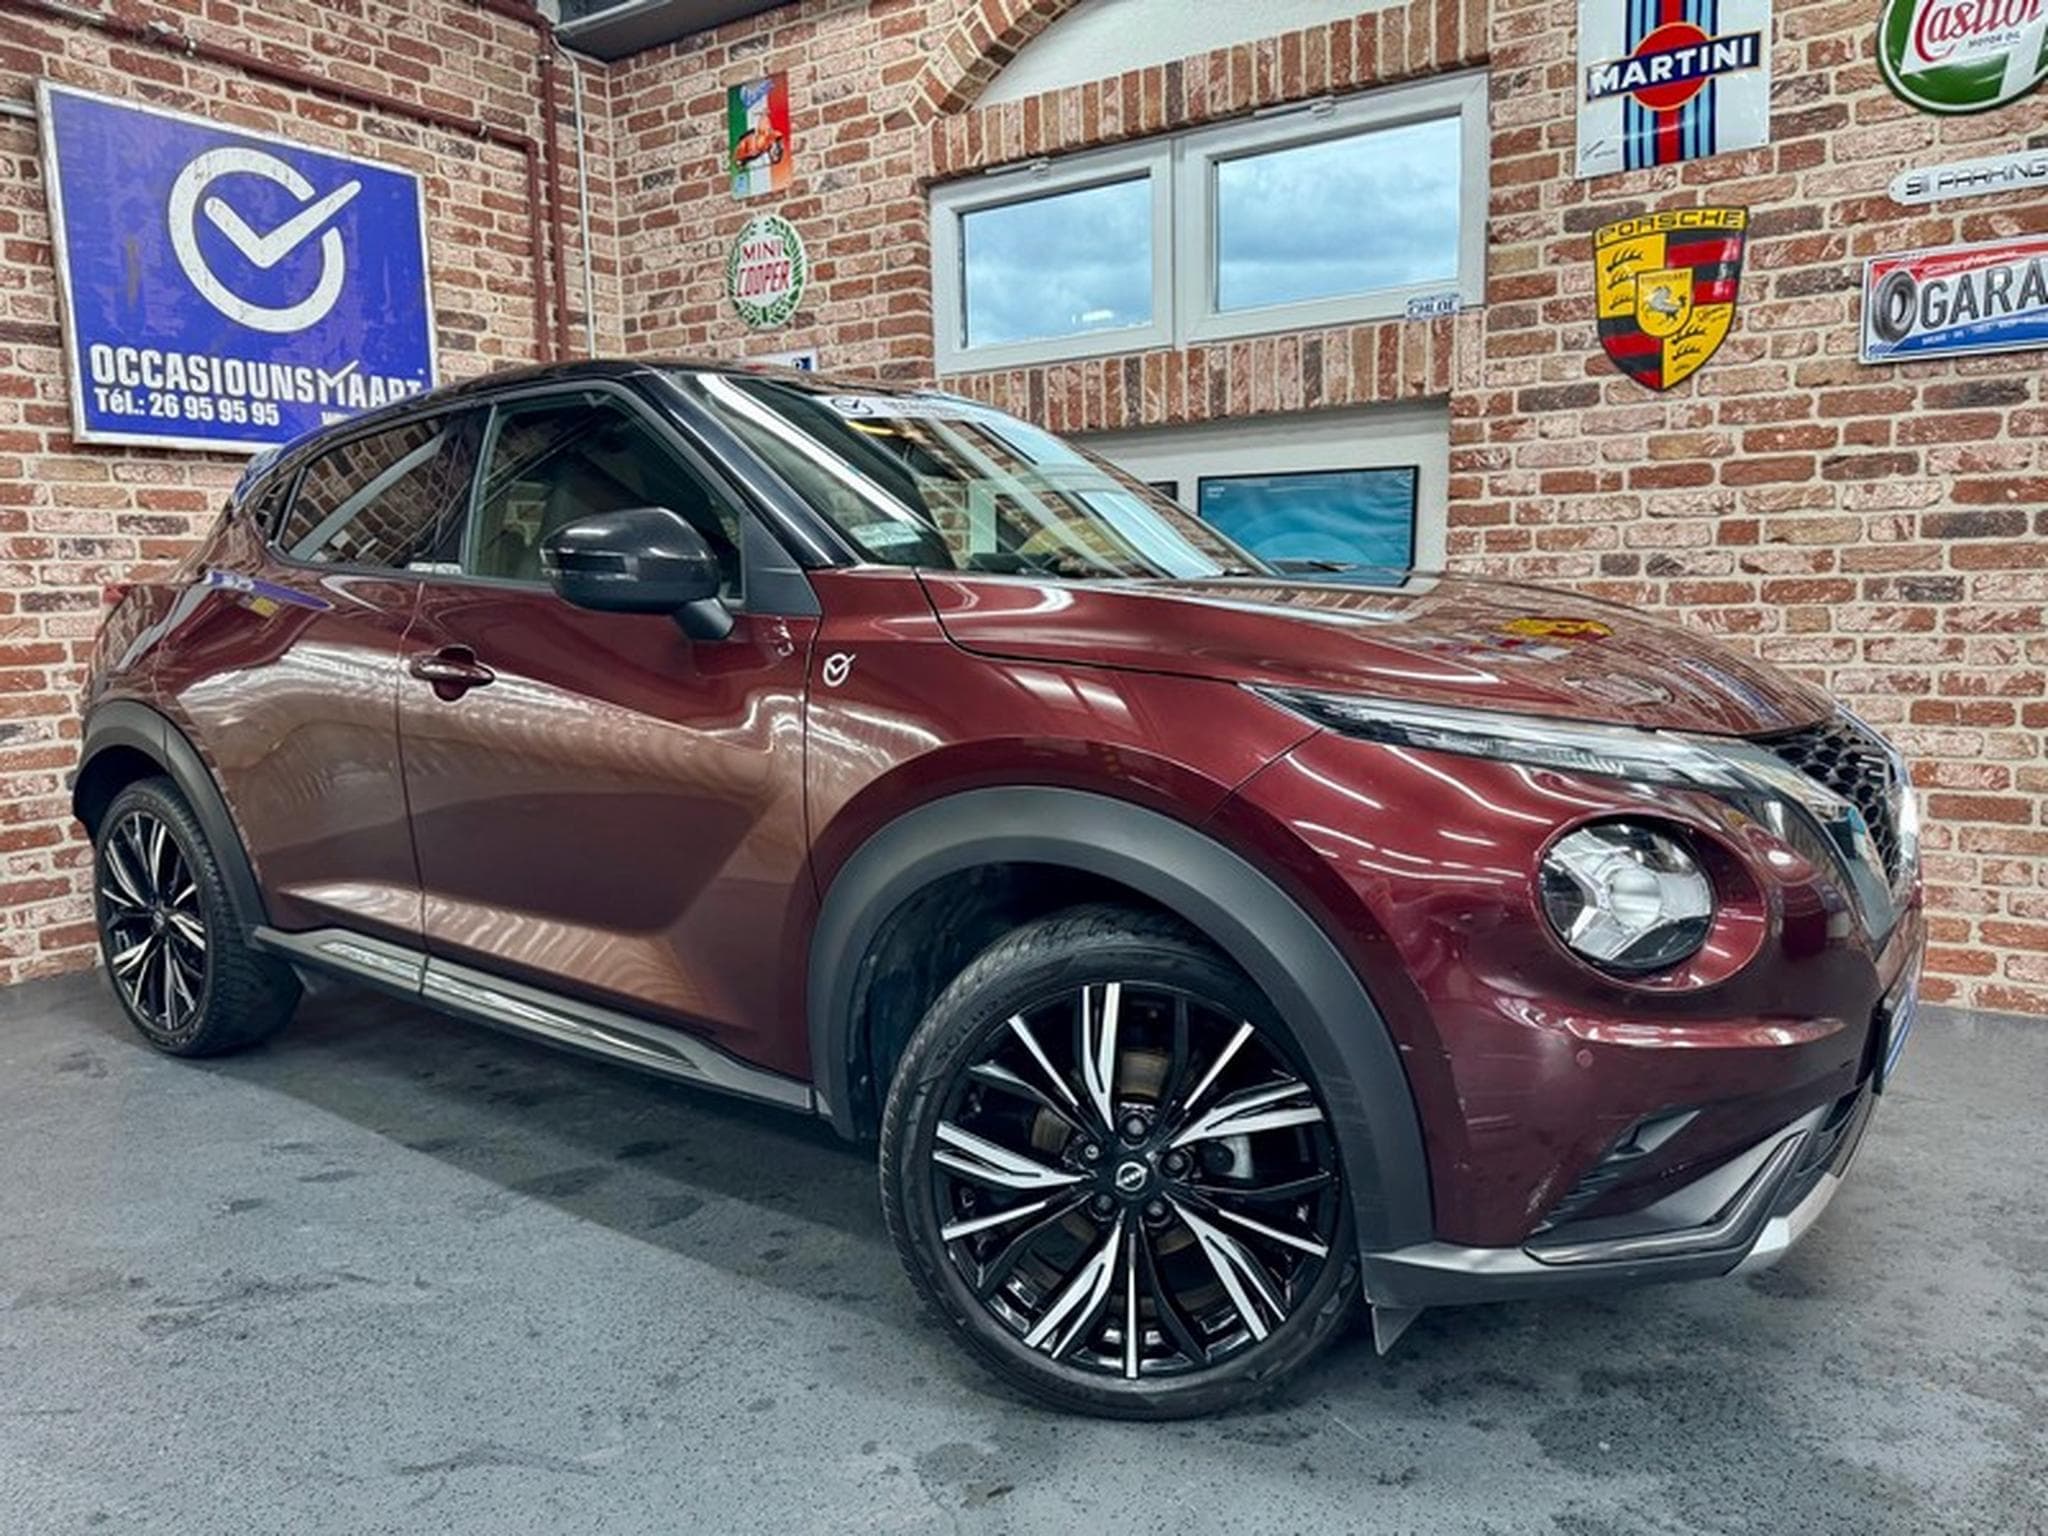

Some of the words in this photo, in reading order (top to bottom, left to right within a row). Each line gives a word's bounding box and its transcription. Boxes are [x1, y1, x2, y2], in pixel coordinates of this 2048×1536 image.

[1967, 34, 2003, 49] MOTOR
[1589, 37, 1752, 96] MARTINI
[1937, 157, 2047, 192] PARKING
[1599, 211, 1742, 244] PORSCHE
[742, 239, 781, 262] MINI
[736, 259, 790, 299] COOPER
[93, 387, 145, 416] Tél.:
[150, 393, 180, 419] 26
[184, 398, 213, 422] 95
[218, 400, 248, 424] 95
[251, 402, 280, 427] 95
